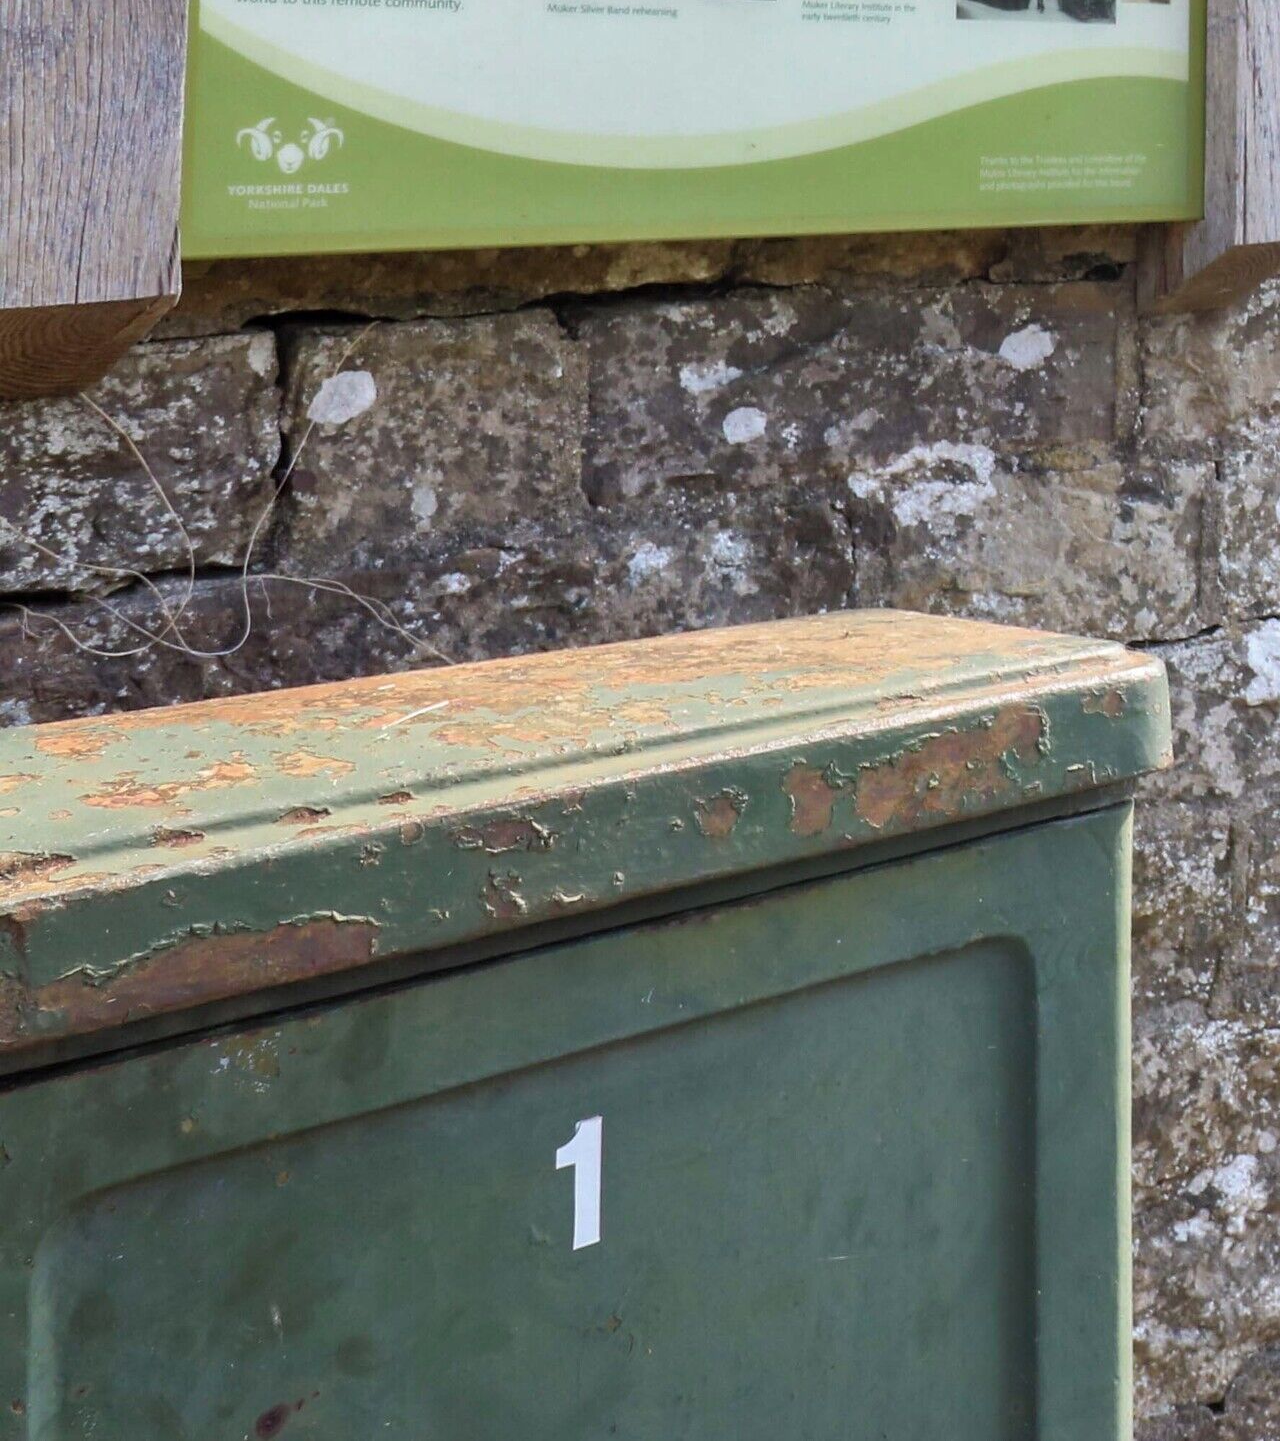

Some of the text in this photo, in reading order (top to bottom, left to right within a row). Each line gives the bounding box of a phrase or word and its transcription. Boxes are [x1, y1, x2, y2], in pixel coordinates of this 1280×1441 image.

[228, 183, 348, 196] YORKSHIRE DALES
[248, 196, 328, 210] National Park
[556, 1116, 602, 1251] 1
